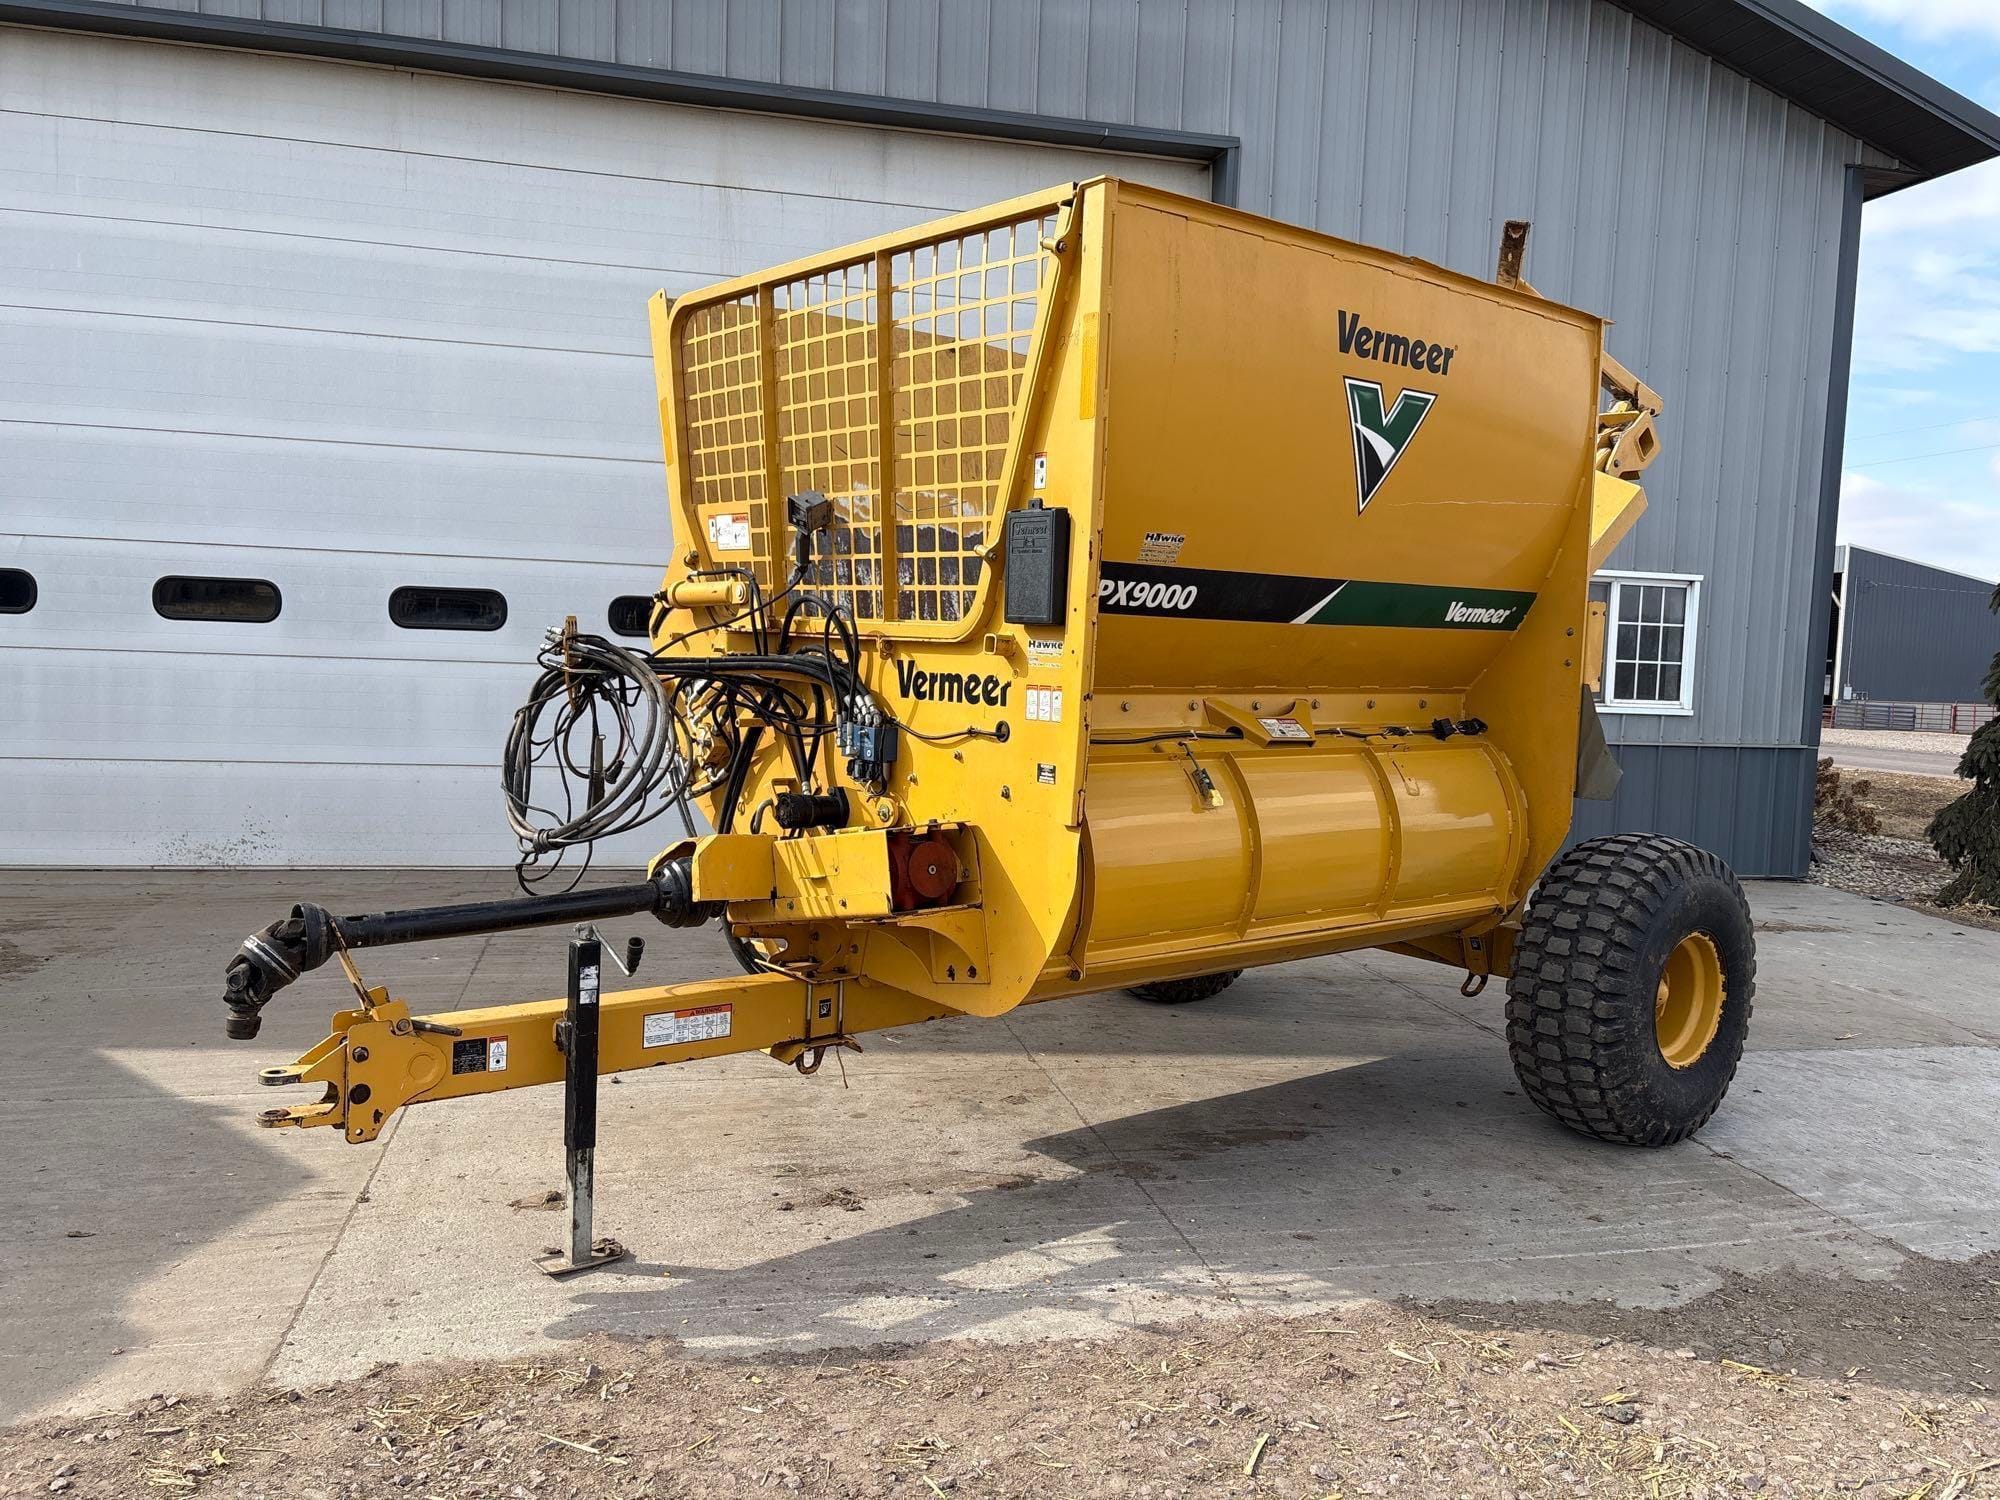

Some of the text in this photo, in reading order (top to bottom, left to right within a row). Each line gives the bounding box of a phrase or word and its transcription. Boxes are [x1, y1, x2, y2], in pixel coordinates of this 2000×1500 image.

[1338, 309, 1454, 376] Vermeer
[1098, 579, 1198, 610] PX9000
[1444, 601, 1512, 624] Vermeer
[897, 660, 1012, 707] Vermeer
